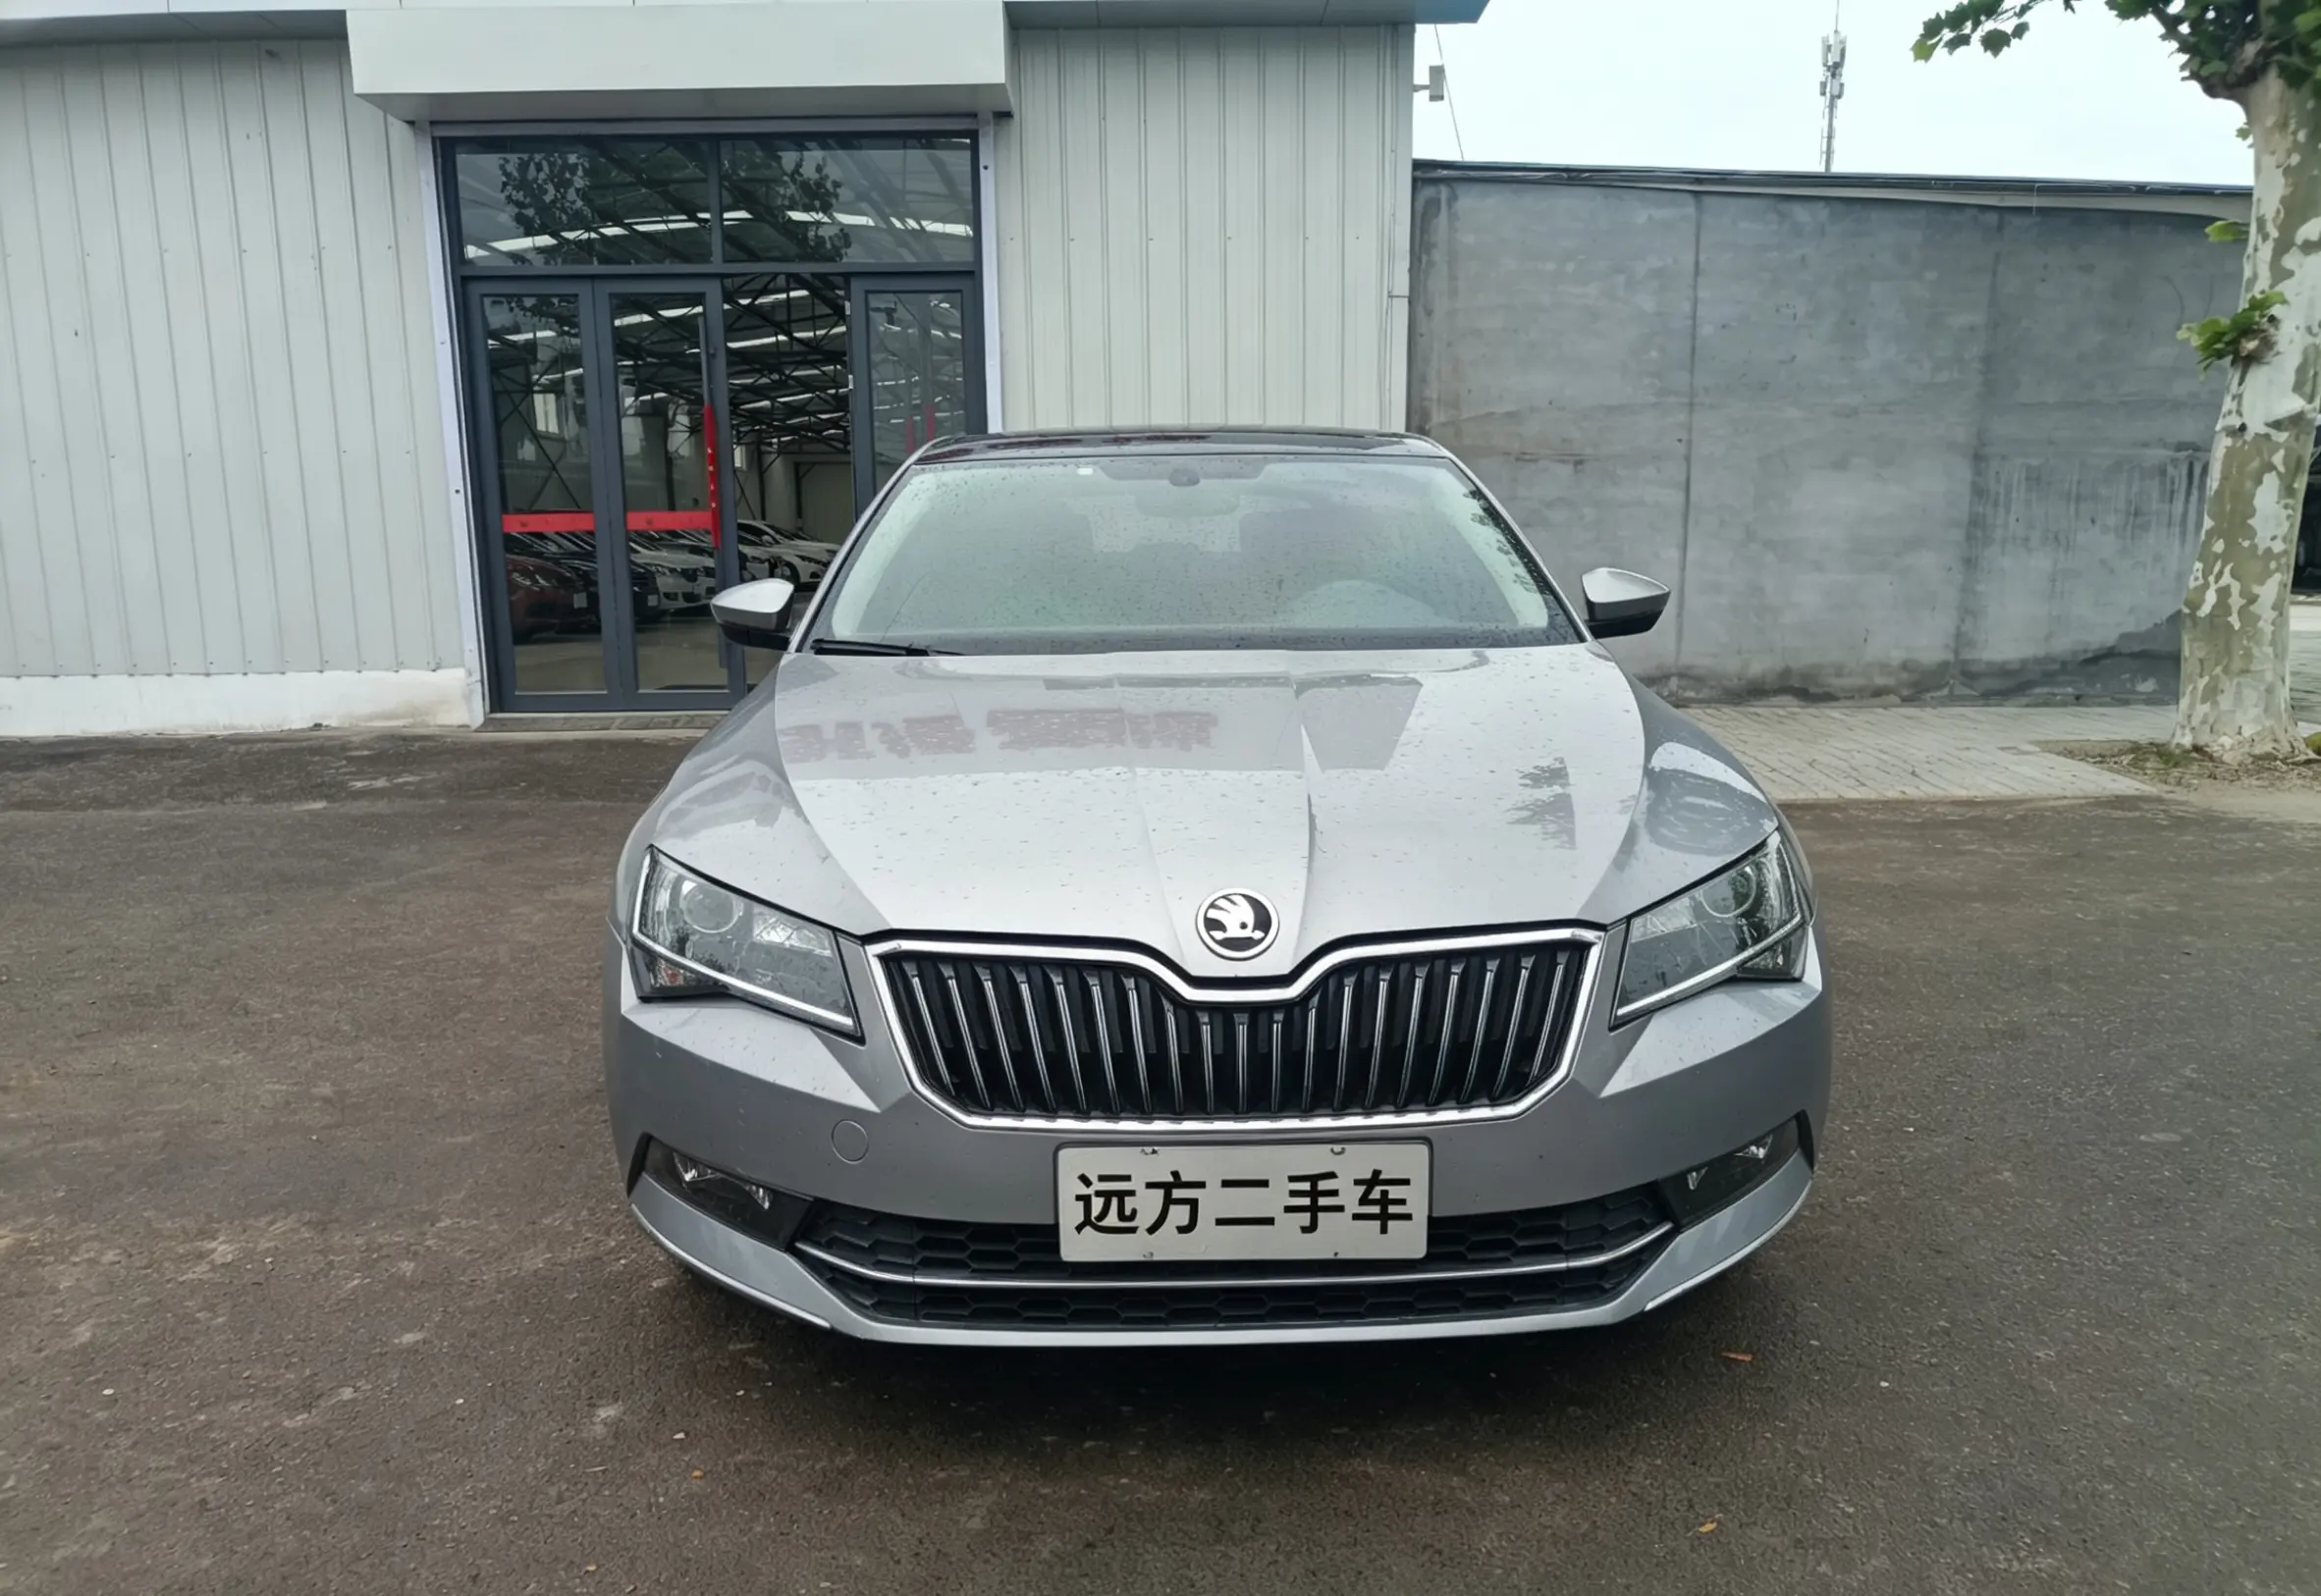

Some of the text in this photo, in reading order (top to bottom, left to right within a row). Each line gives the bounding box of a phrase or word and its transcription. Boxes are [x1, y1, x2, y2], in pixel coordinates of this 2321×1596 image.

[1074, 1169, 1413, 1235] 远方二手车
